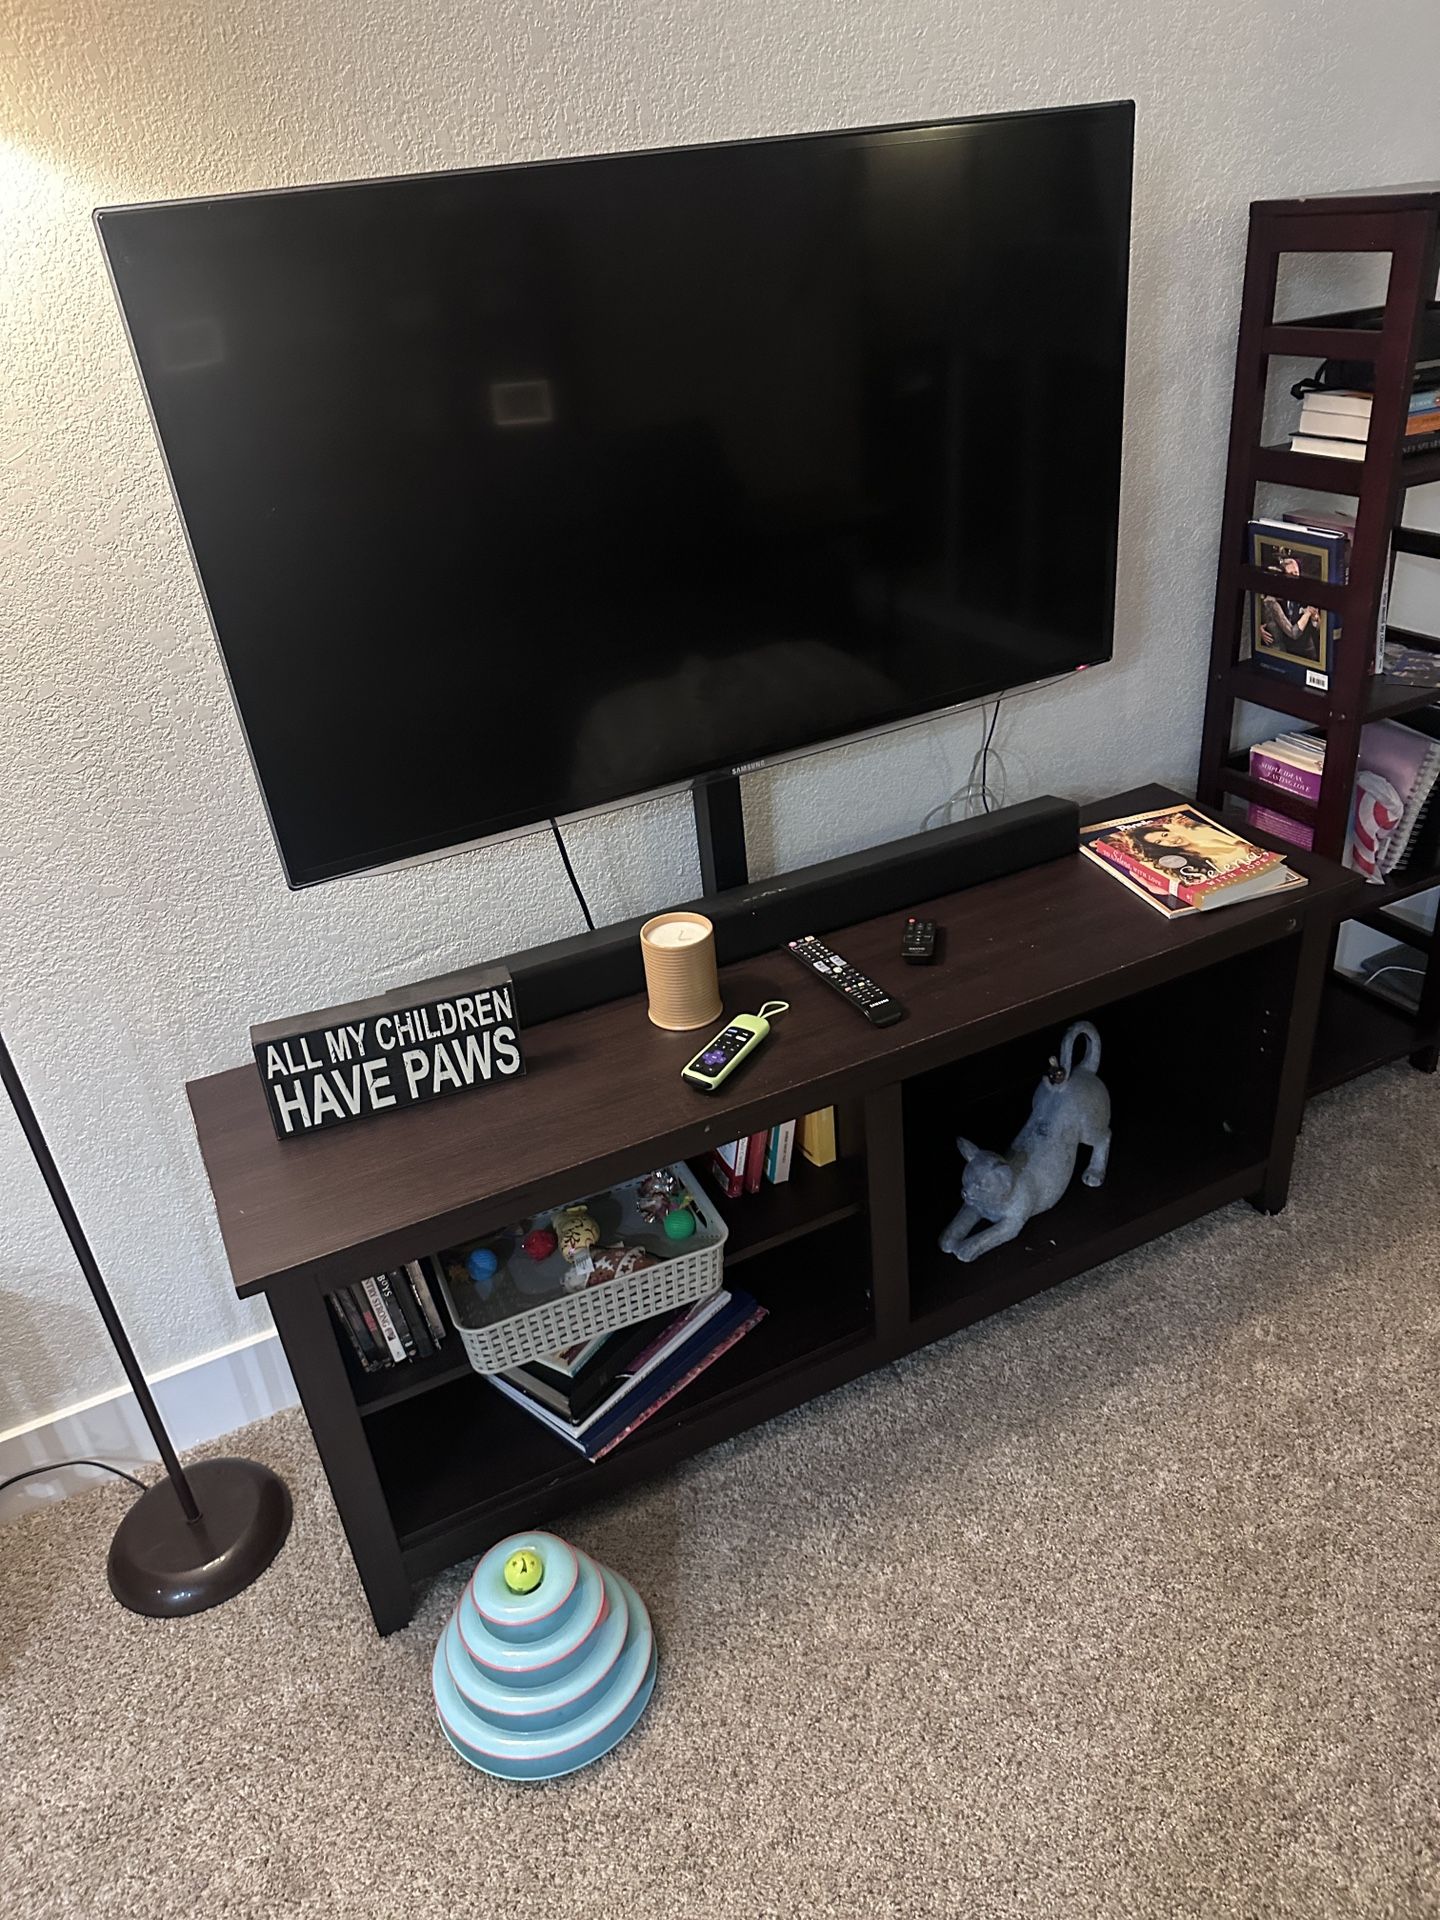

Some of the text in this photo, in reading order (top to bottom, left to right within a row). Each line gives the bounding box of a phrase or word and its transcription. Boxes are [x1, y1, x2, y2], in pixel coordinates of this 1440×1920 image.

[1179, 851, 1270, 886] Selena,
[1206, 857, 1270, 886] WITH LOVE
[266, 986, 514, 1080] ALL MY CHILDREN
[273, 1026, 522, 1133] HAVE PAWS
[371, 1296, 391, 1329] STRONG
